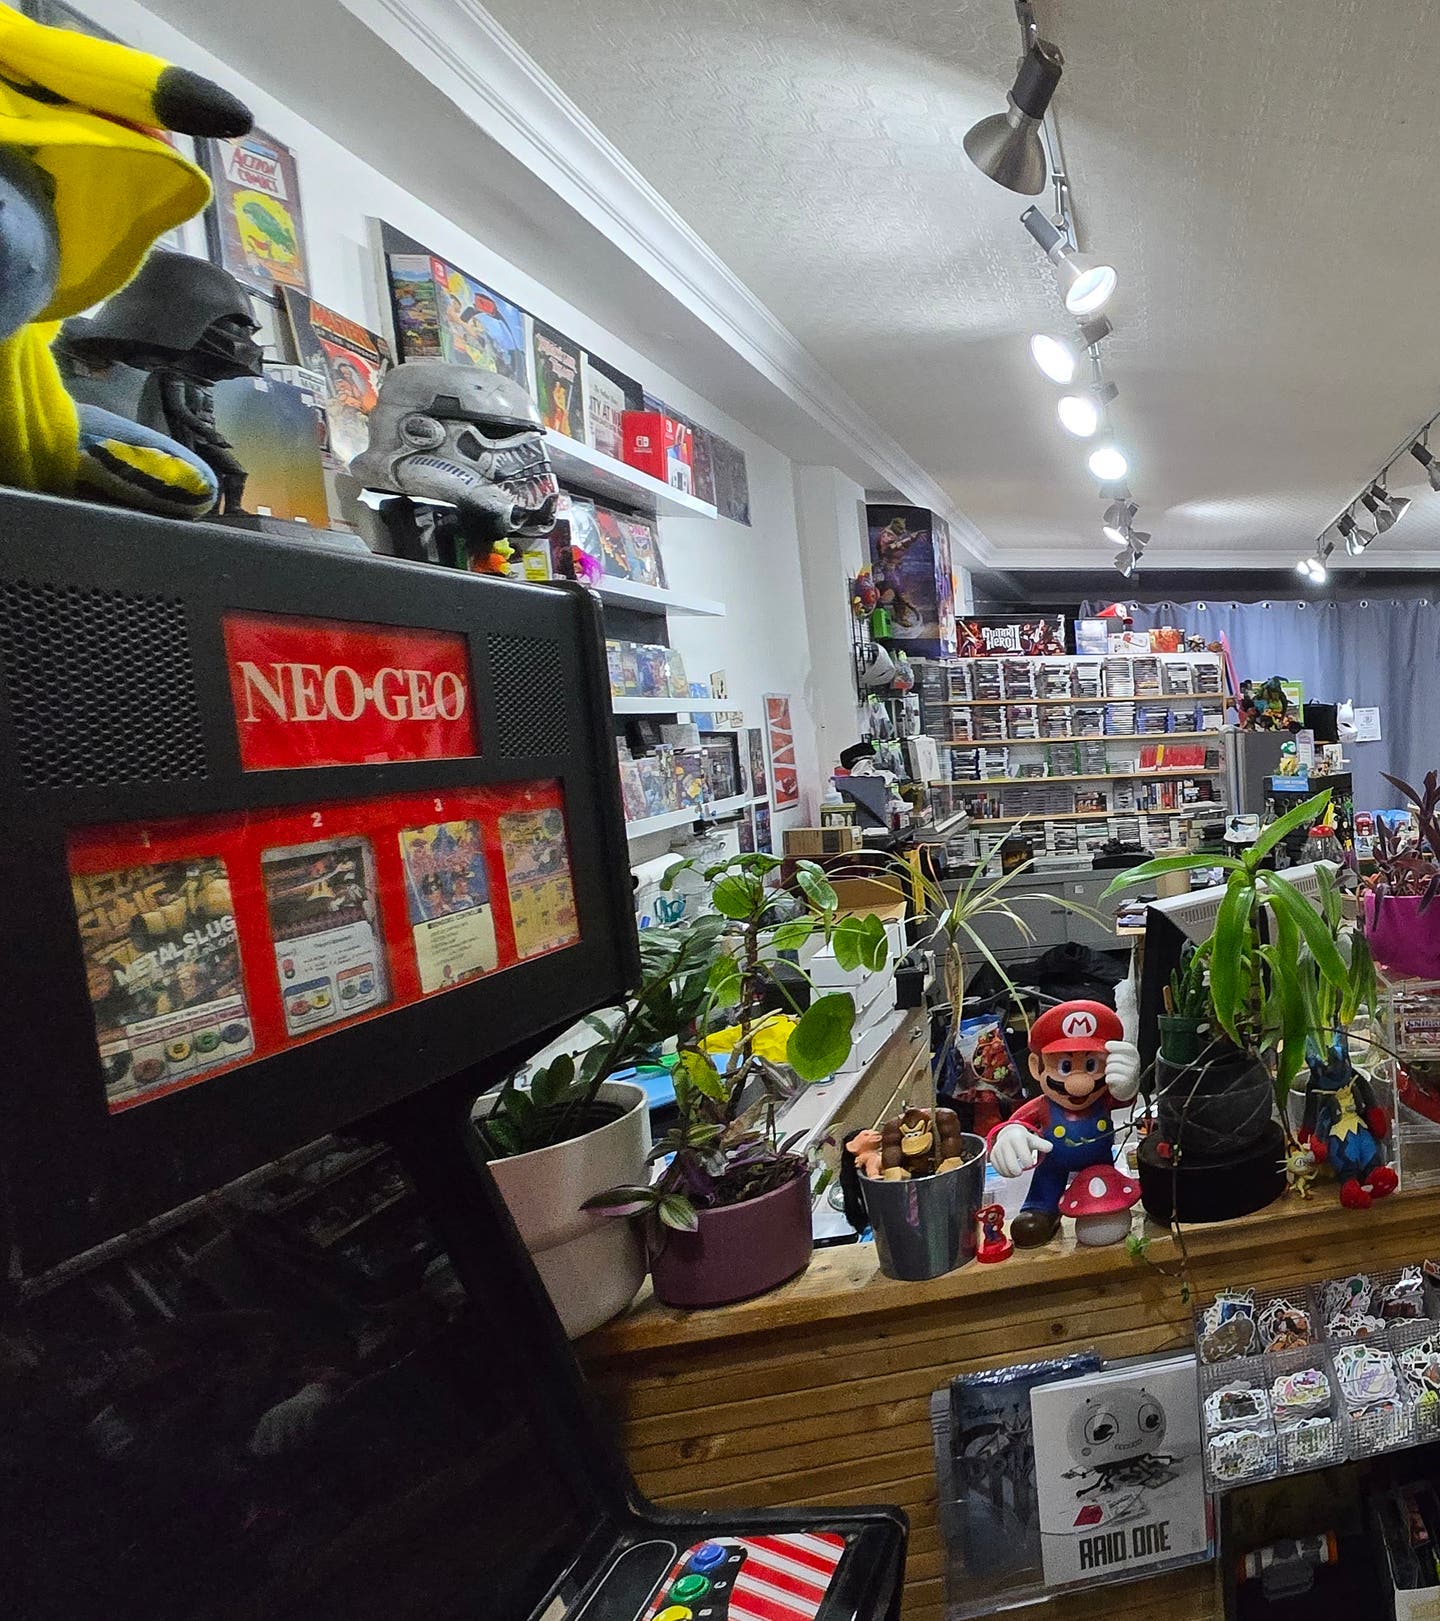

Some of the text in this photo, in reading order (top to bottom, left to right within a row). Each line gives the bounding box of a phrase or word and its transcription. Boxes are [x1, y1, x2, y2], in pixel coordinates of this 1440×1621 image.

[231, 146, 277, 177] ACTION
[433, 798, 443, 812] 3
[310, 812, 323, 827] 2
[1067, 1014, 1094, 1037] M
[1078, 1520, 1172, 1571] RAID.ONE
